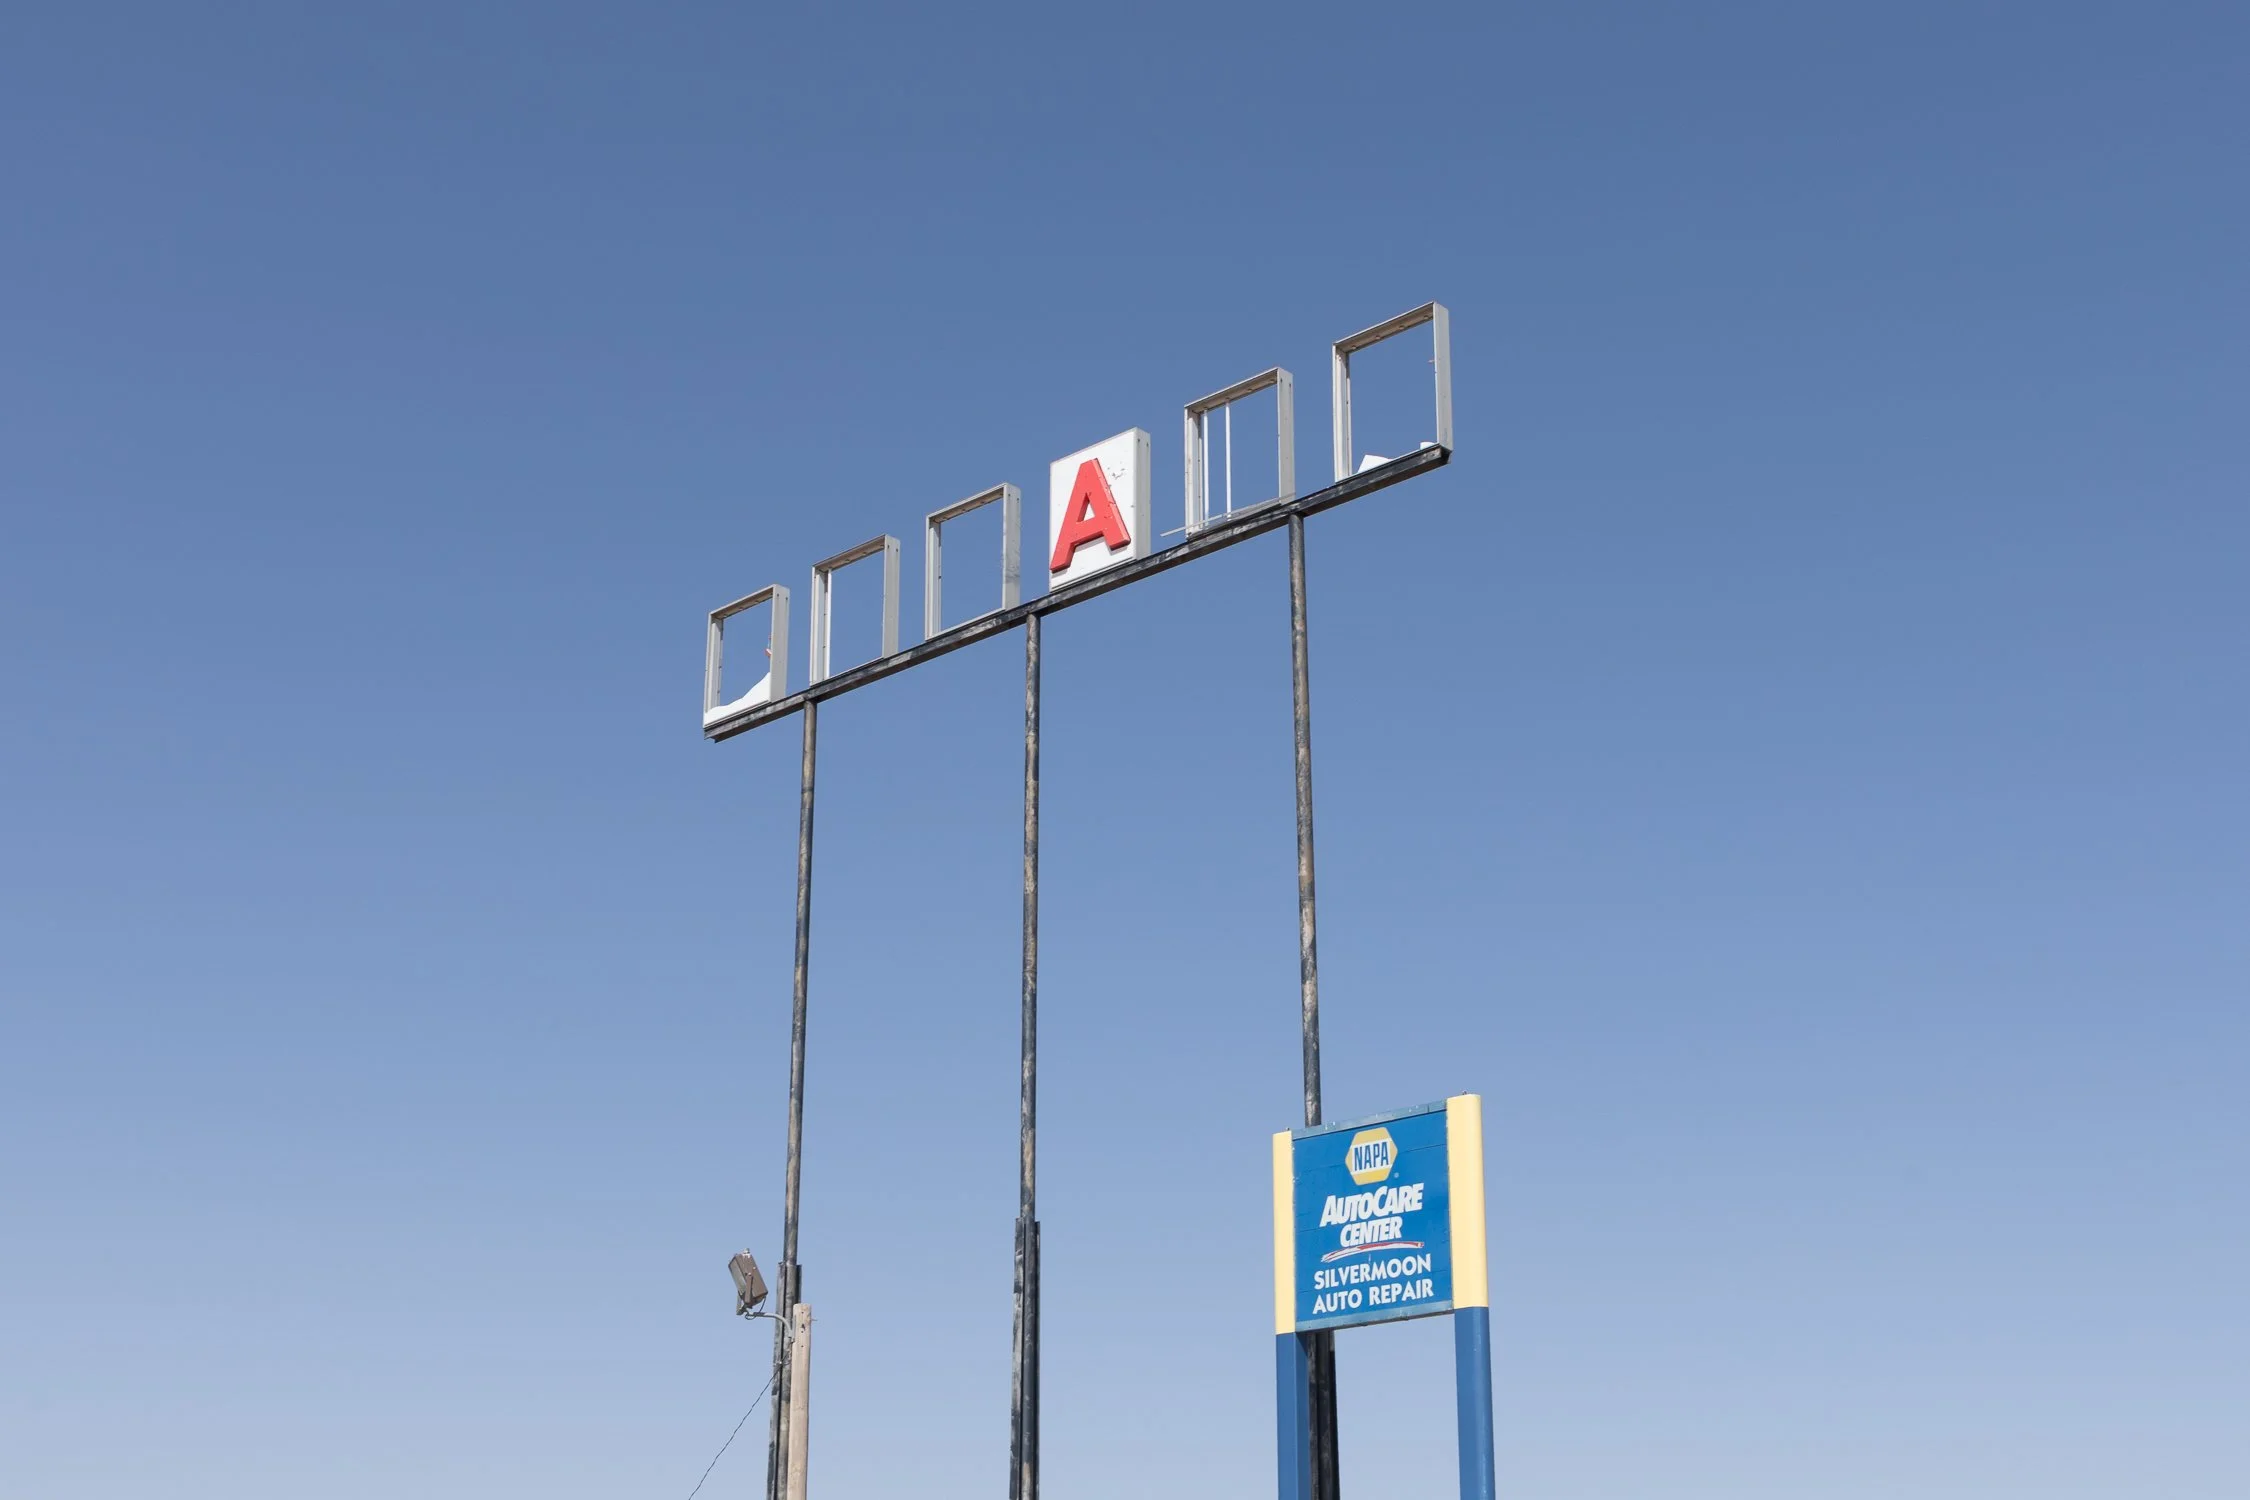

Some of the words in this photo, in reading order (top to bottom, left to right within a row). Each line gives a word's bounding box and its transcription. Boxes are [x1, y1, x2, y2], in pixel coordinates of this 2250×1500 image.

[1050, 457, 1131, 573] A
[1353, 1141, 1390, 1171] NAPA
[1340, 1216, 1402, 1247] CENTER
[1313, 1253, 1431, 1290] SILVERMOON
[1312, 1289, 1362, 1314] AUTO
[1369, 1278, 1434, 1305] REPAIR
